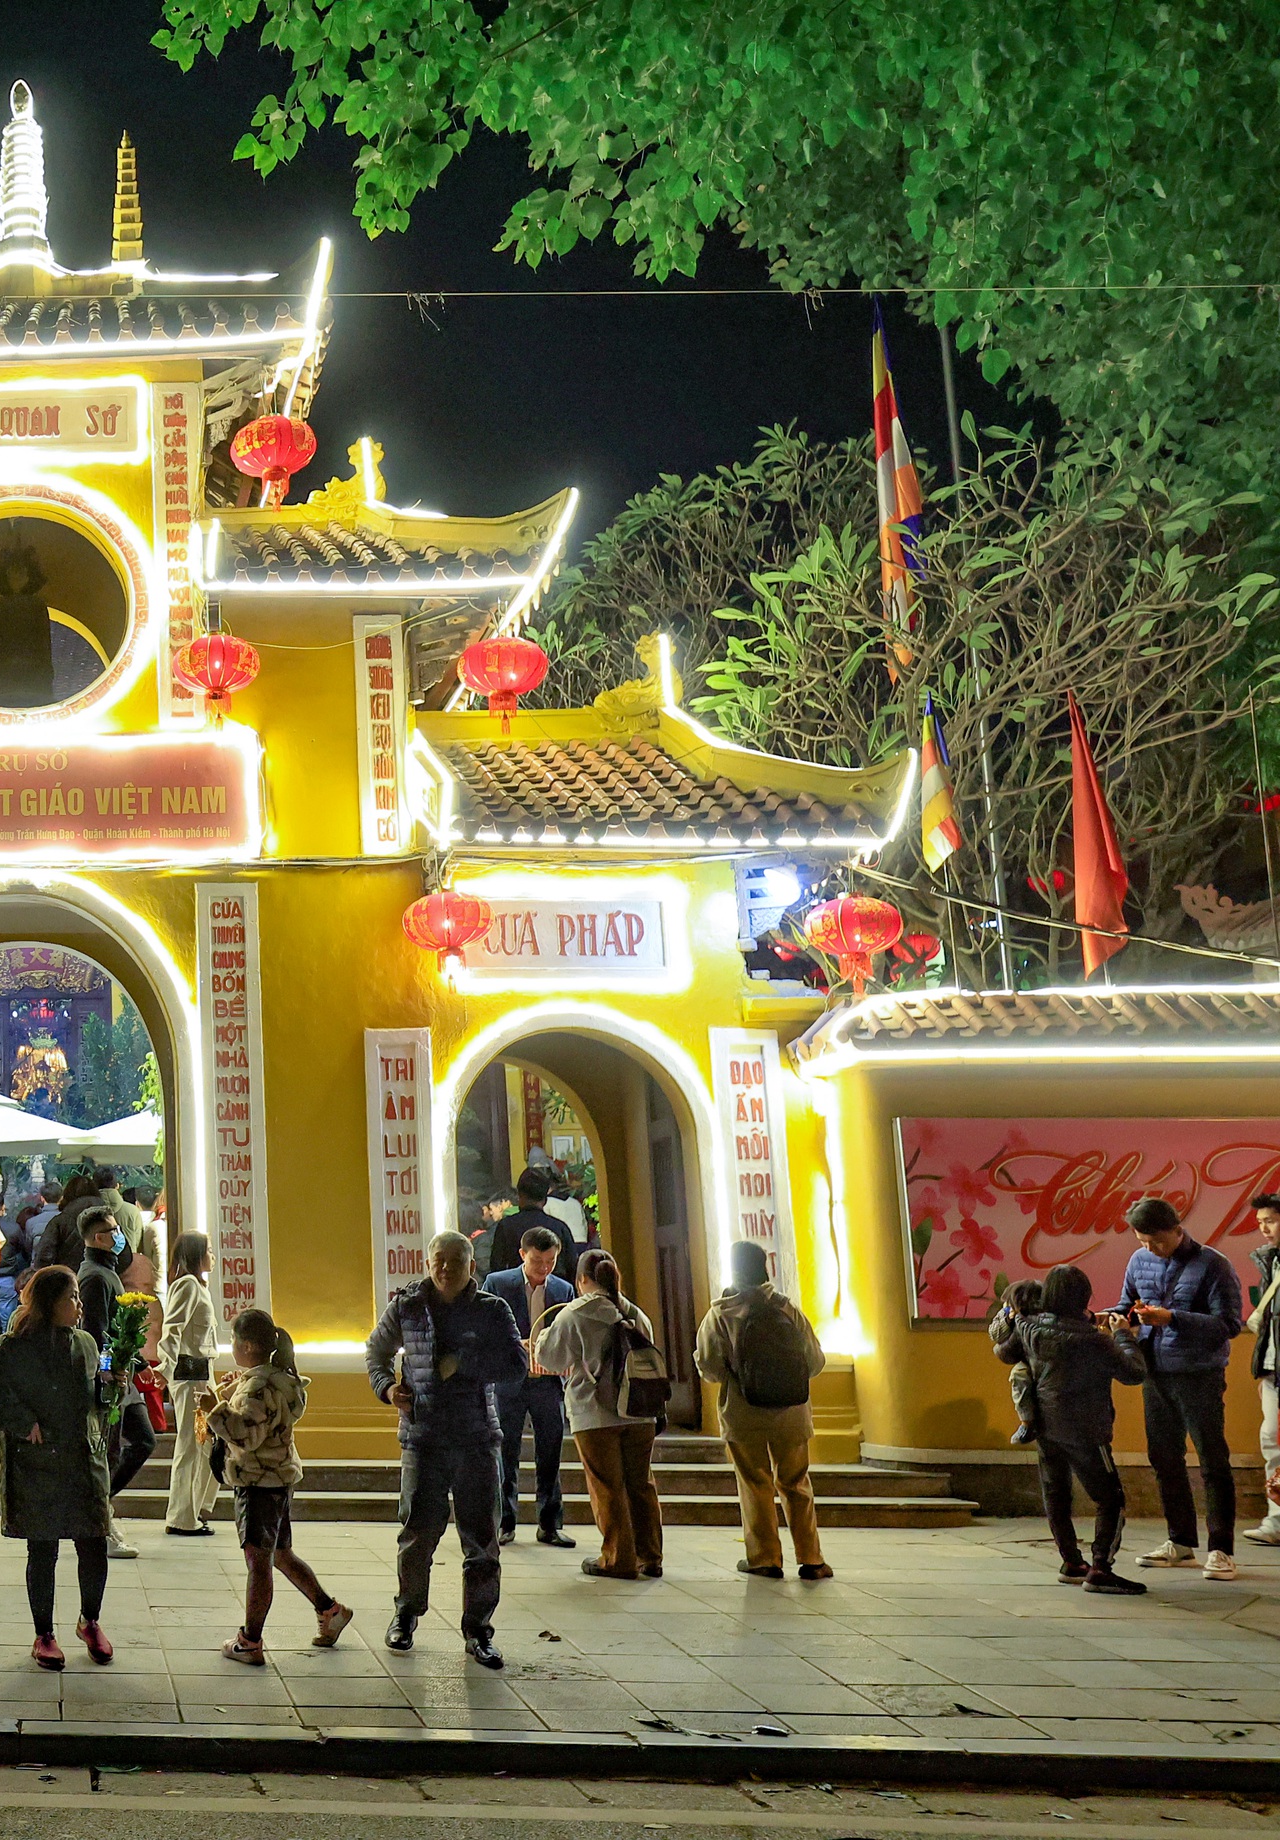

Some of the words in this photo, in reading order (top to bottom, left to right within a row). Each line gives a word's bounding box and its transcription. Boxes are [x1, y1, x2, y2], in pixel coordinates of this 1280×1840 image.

[35, 747, 68, 771] SỞ
[20, 782, 85, 816] GIÁO
[94, 782, 153, 820] VIỆT
[161, 786, 226, 814] NAM
[376, 785, 397, 811] KIM
[186, 825, 201, 839] phố
[203, 827, 214, 838] Hà
[216, 826, 231, 840] Nội
[211, 898, 243, 919] CỬA
[556, 910, 645, 957] PHÁP
[212, 950, 245, 970] CHUNG
[212, 971, 245, 993] BỐN
[215, 1022, 247, 1047] MỘT
[216, 1046, 249, 1068] NHÀ
[218, 1127, 250, 1147] TU
[384, 1132, 417, 1158] LUI
[222, 1257, 254, 1277] NGU
